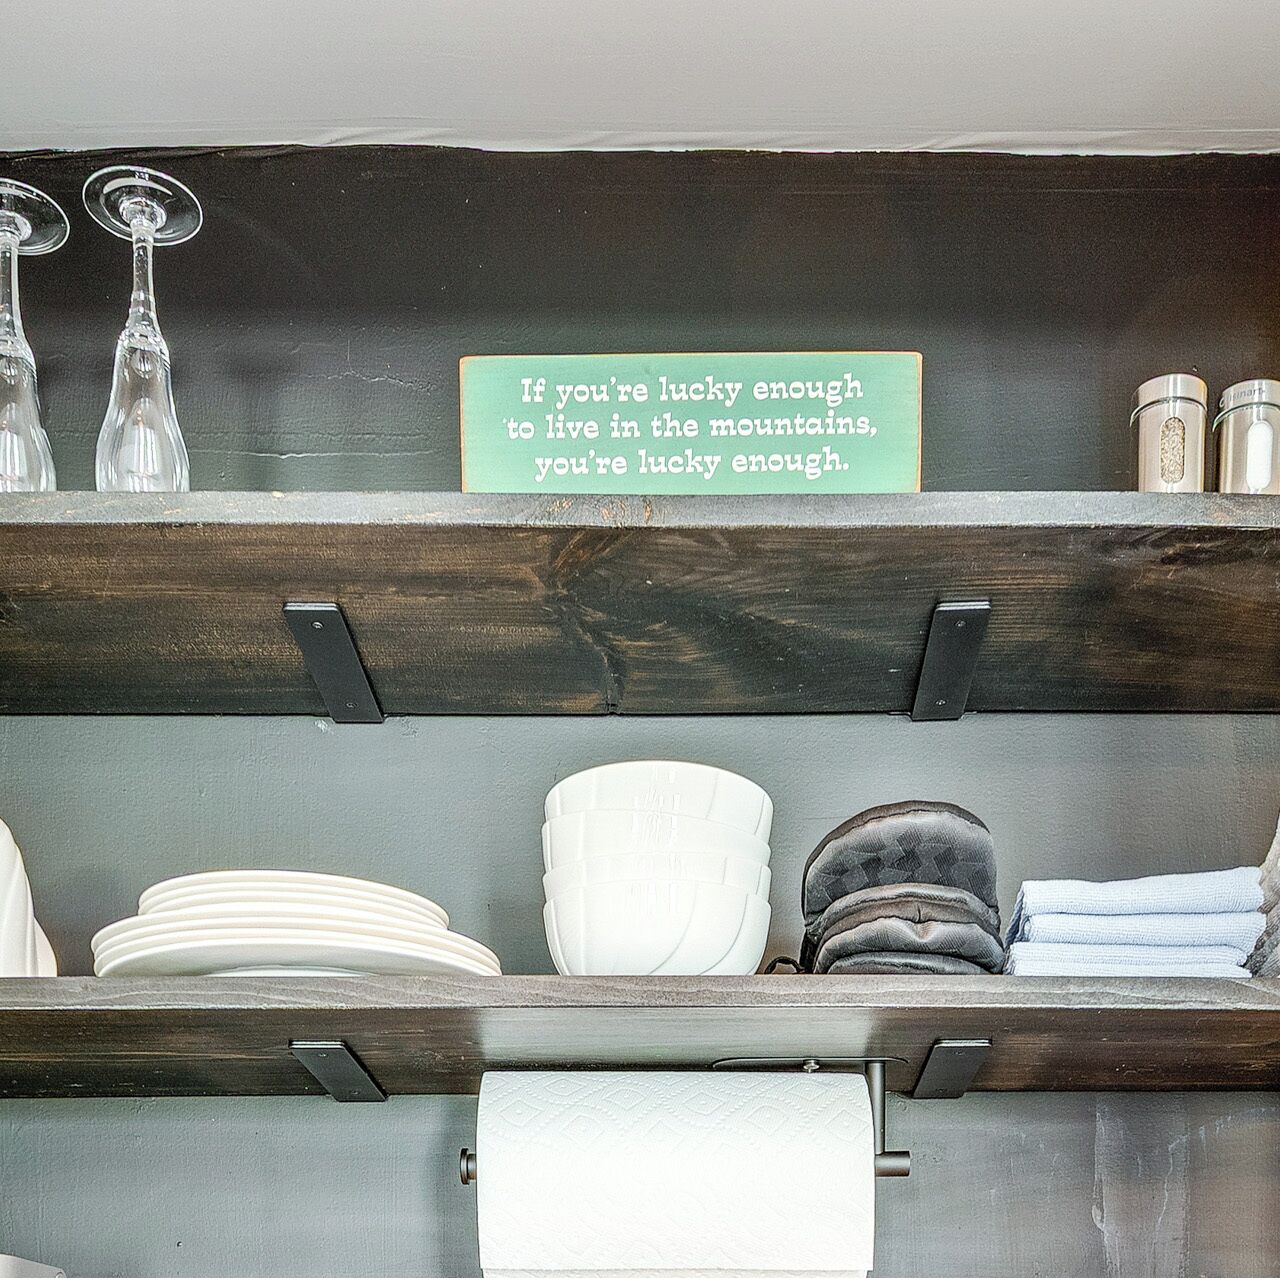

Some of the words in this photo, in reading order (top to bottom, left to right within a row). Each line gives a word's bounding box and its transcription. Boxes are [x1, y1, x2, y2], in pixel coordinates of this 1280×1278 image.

[520, 377, 546, 403] If
[556, 377, 649, 411] you're
[659, 376, 743, 407] lucky
[752, 373, 864, 408] enough
[506, 416, 535, 439] to
[546, 413, 599, 439] live
[609, 412, 641, 438] in
[650, 412, 699, 438] the
[709, 409, 878, 438] mountains,
[534, 448, 628, 482] you're
[637, 449, 721, 480] lucky
[730, 446, 850, 480] enough.
